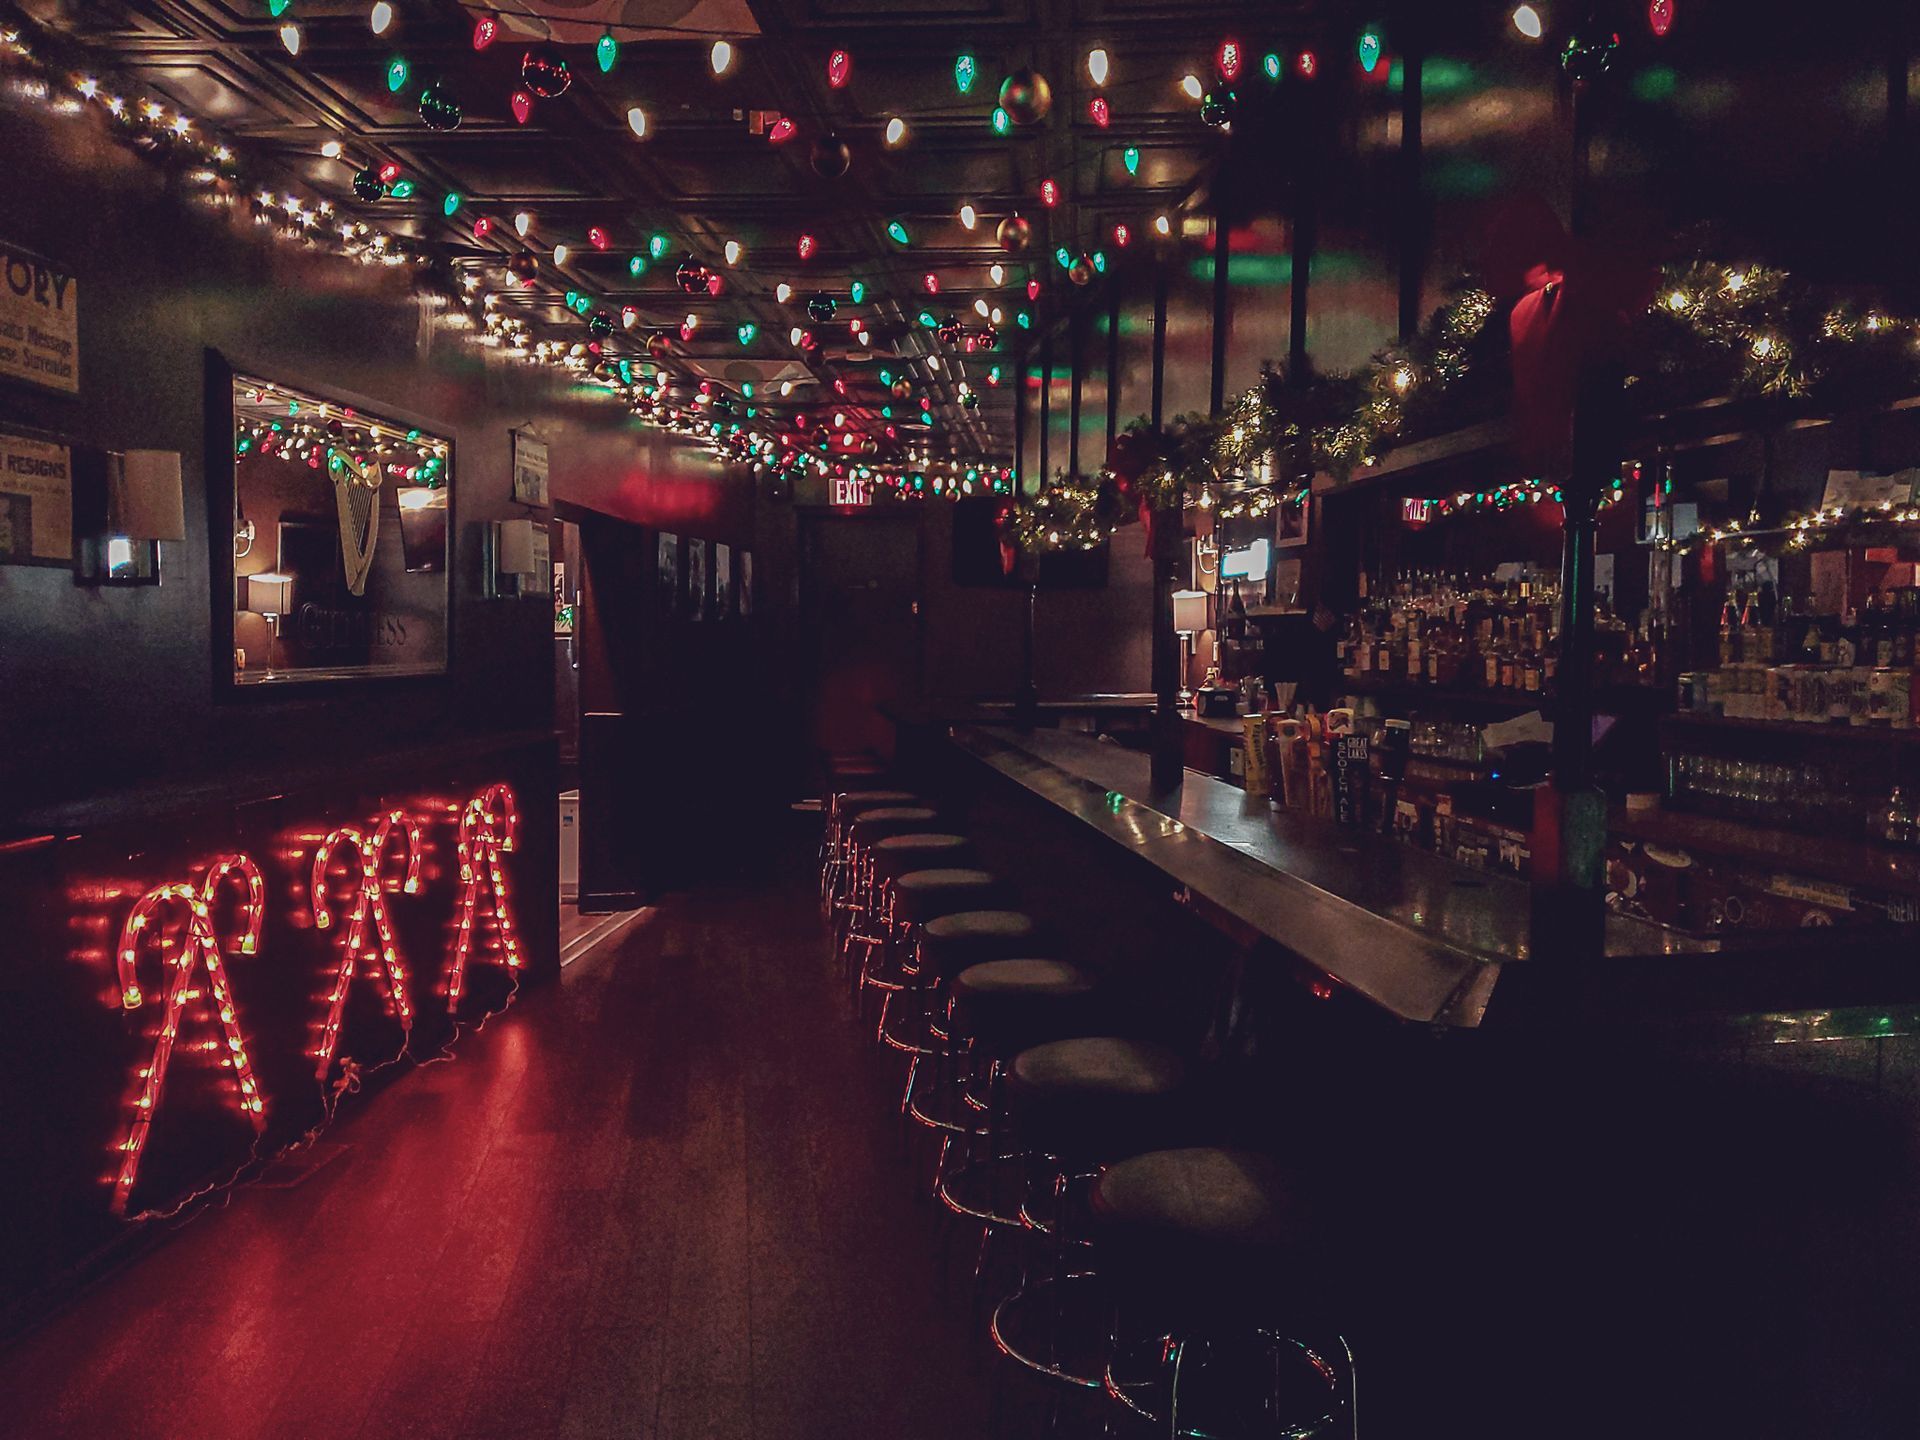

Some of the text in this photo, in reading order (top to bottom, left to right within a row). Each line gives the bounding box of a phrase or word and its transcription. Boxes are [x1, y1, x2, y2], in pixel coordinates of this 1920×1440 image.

[8, 454, 66, 479] RESIGNS
[836, 480, 865, 505] EXIT
[1347, 737, 1368, 748] GREAT
[1347, 748, 1368, 759] LAKES
[1337, 742, 1348, 792] SCOTCH
